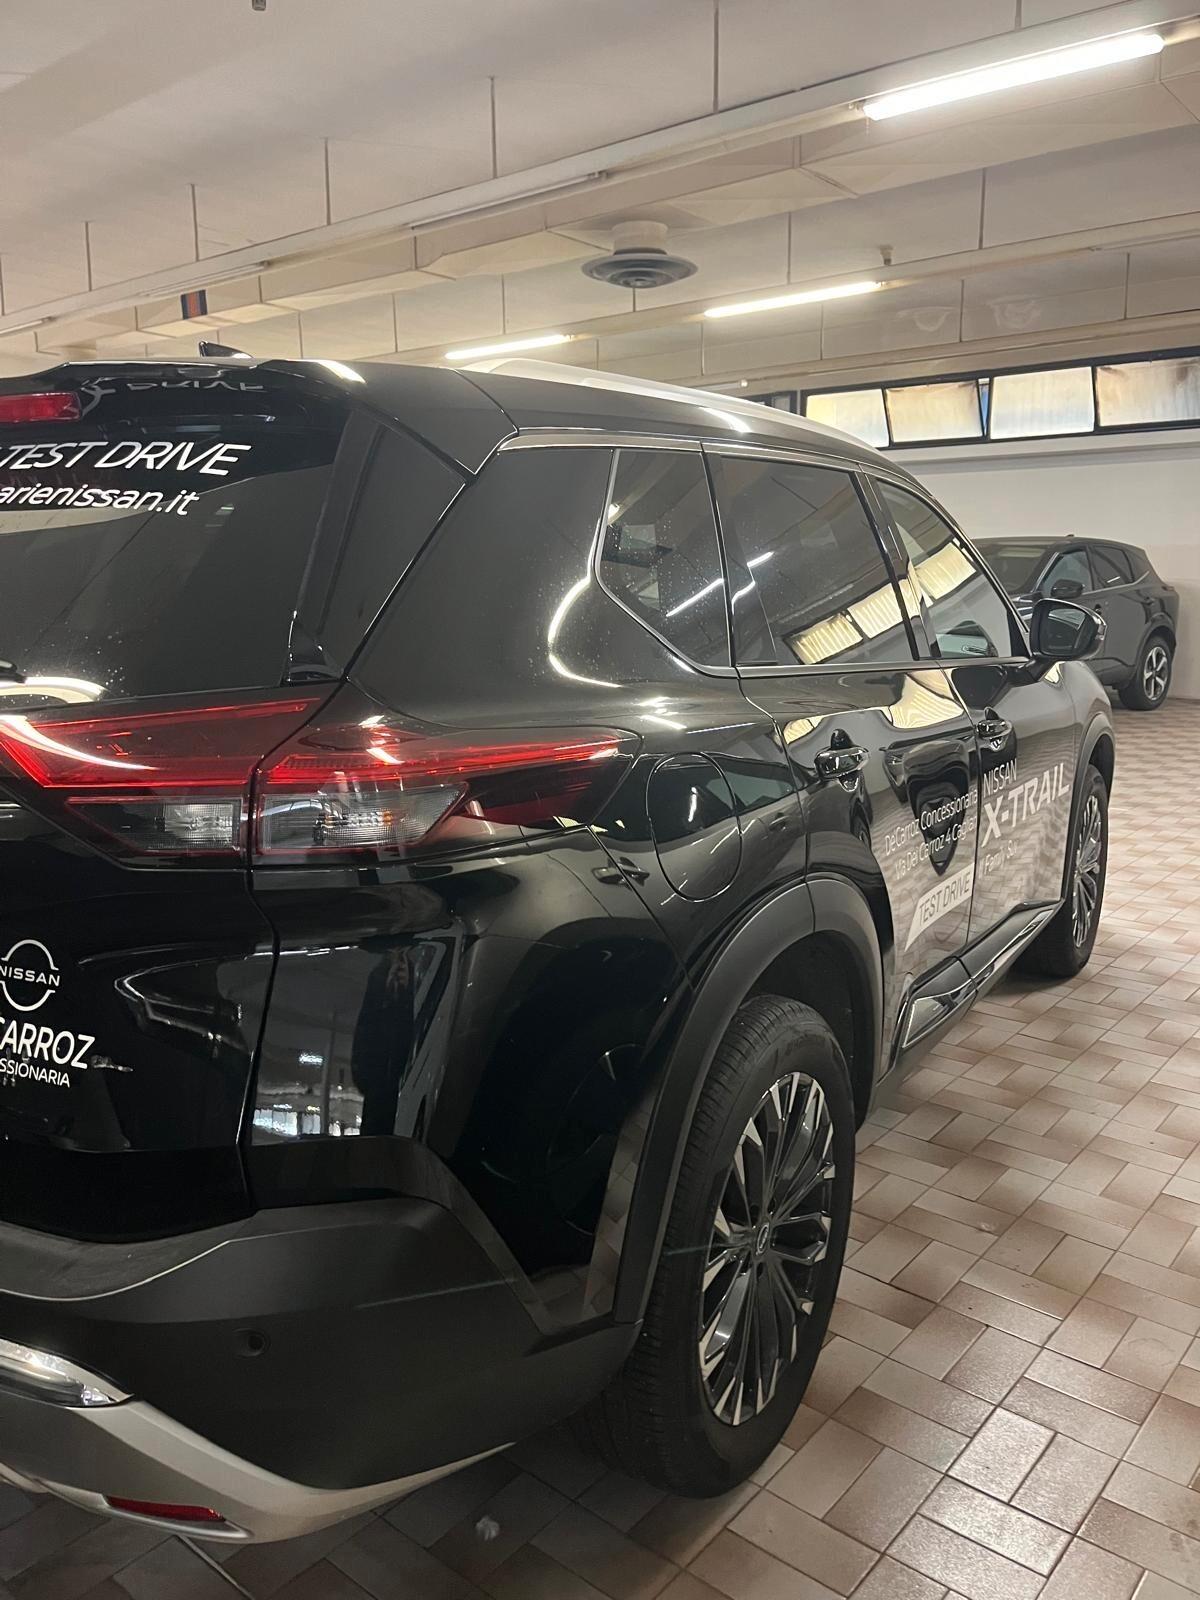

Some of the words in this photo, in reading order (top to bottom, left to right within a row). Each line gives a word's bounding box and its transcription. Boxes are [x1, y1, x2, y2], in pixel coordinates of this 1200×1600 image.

[0, 441, 107, 470] TEST
[95, 441, 251, 476] DRIVE
[983, 758, 1017, 798] NISSAN
[920, 788, 978, 831] Concessionaria
[981, 762, 1070, 848] X-TRAIL
[919, 835, 945, 861] Carroz
[945, 827, 951, 844] 4
[919, 888, 943, 927] TEST
[943, 870, 970, 910] DRIVE
[0, 965, 61, 987] NISSAN
[0, 1016, 96, 1070] ARROZ
